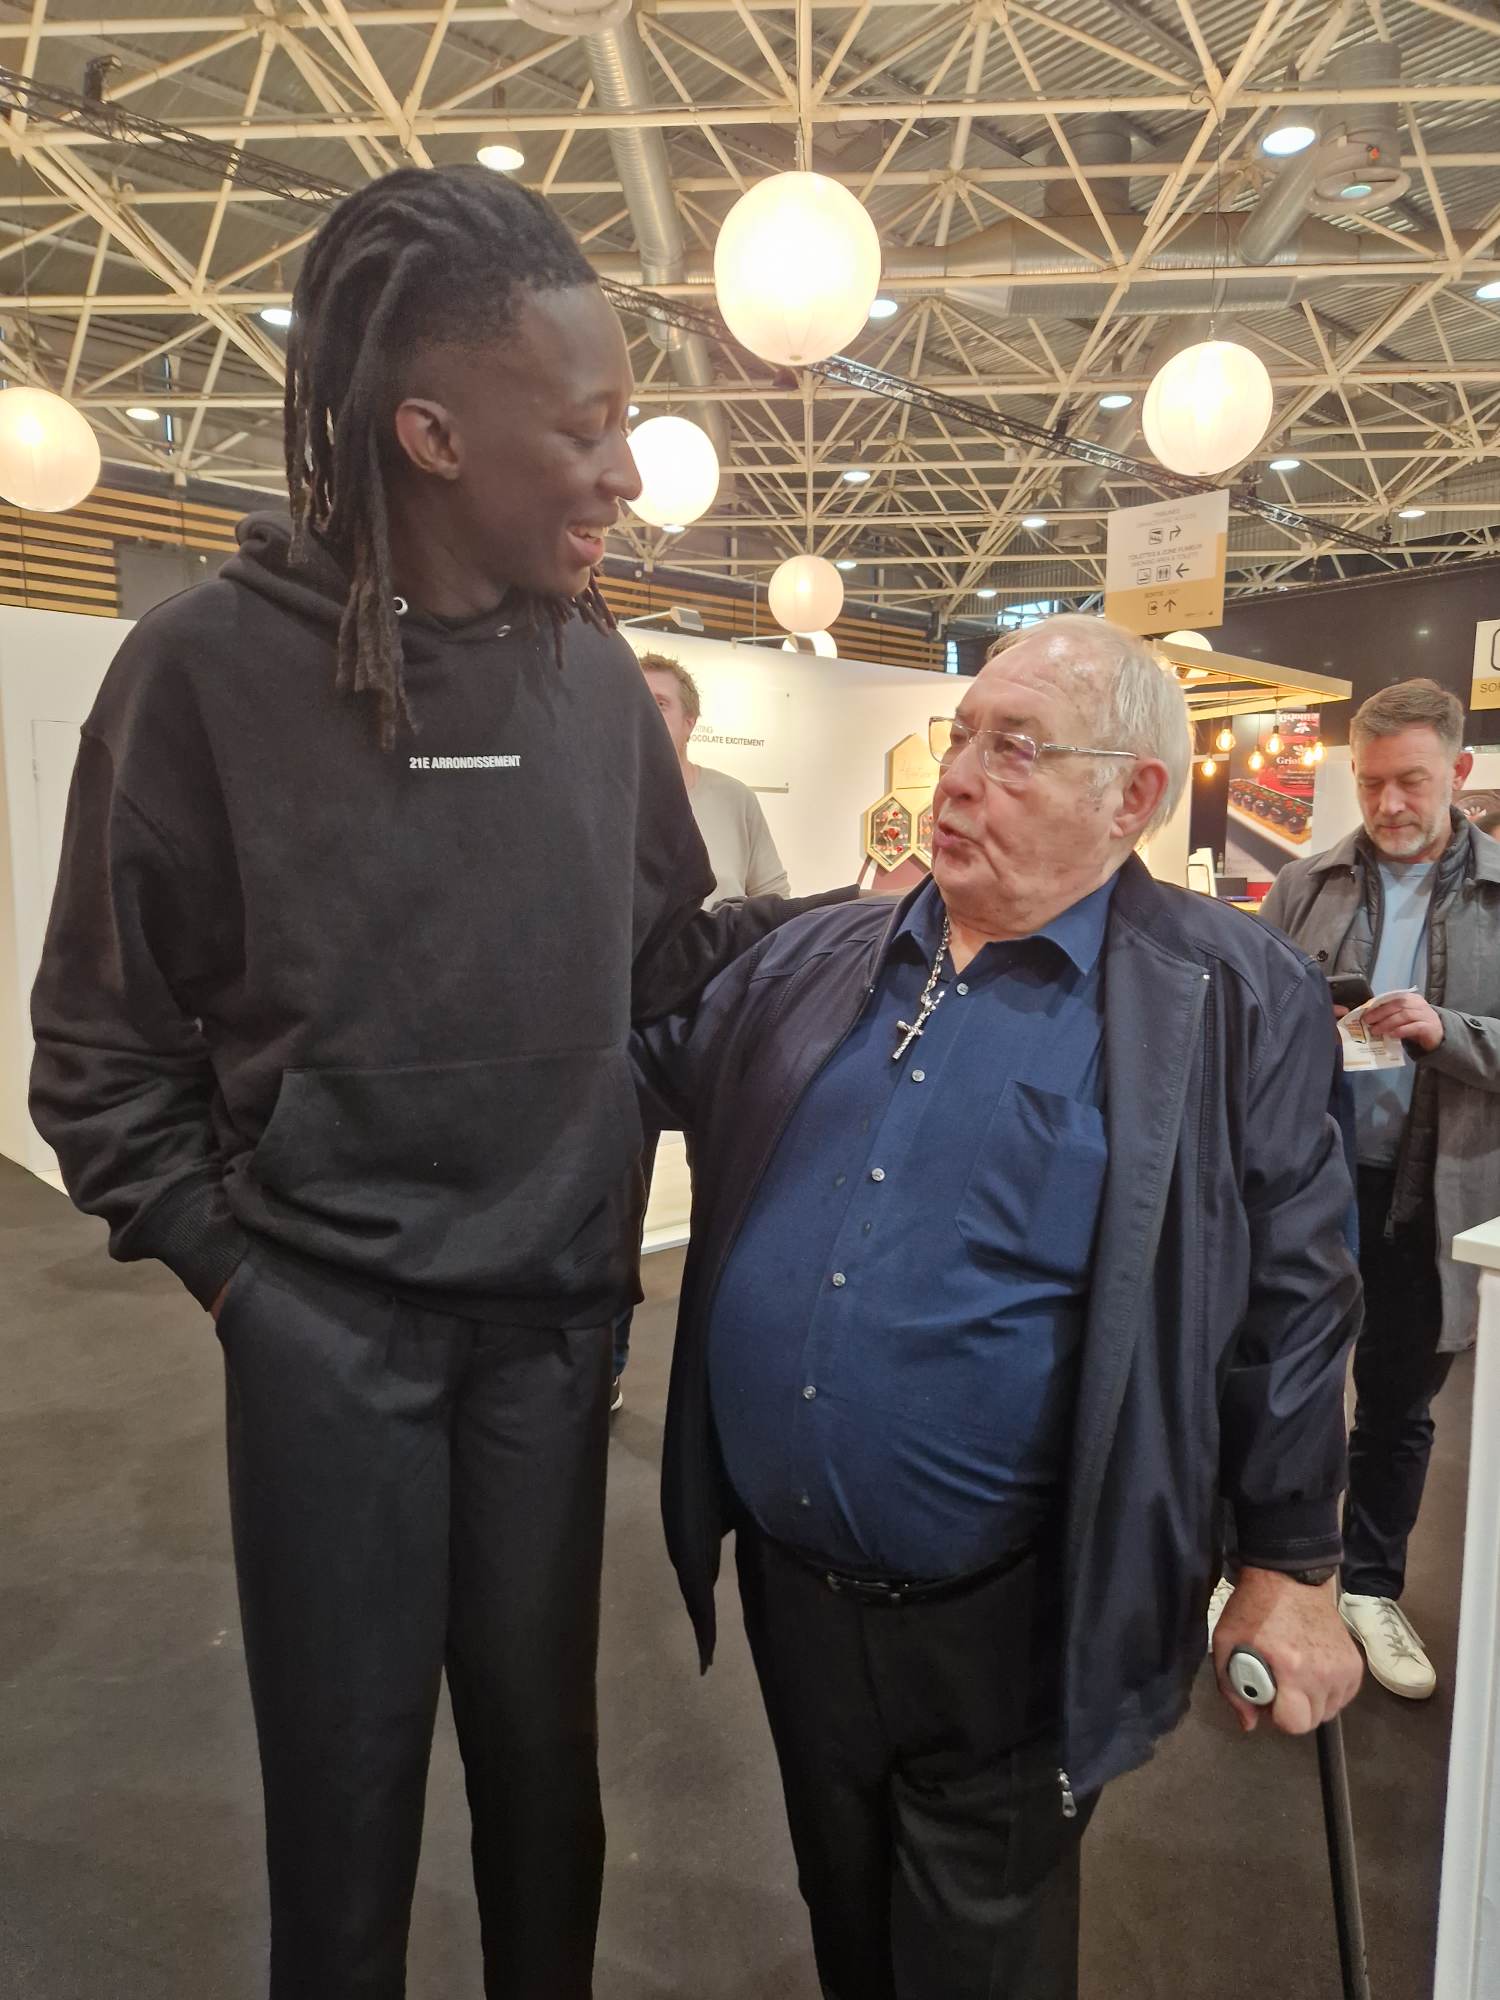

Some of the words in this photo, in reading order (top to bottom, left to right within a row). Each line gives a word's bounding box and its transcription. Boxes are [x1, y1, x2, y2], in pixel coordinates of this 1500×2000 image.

[1479, 682, 1500, 693] SO
[694, 725, 713, 734] ATING
[690, 734, 724, 744] OCOLATE
[725, 736, 765, 747] EXCITEMENT
[409, 757, 430, 769] 21E
[431, 755, 521, 769] ARRONDISSEMENT
